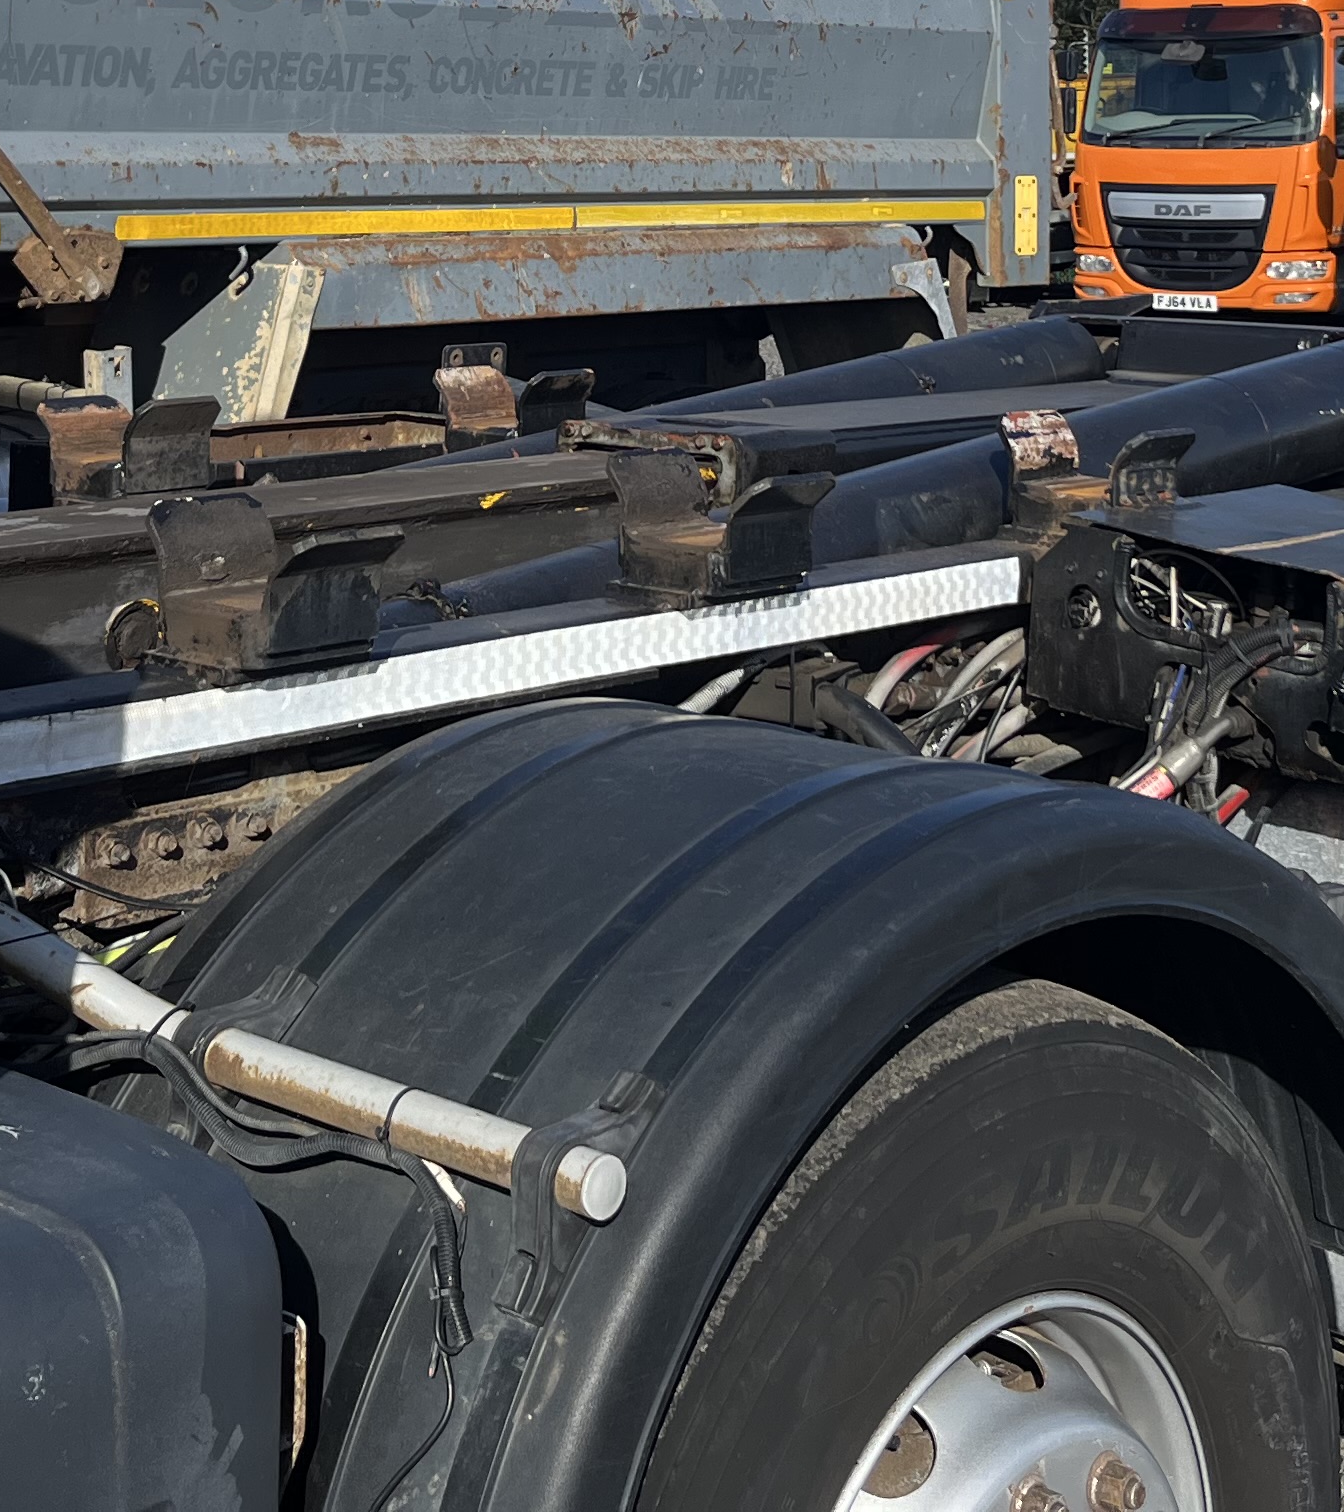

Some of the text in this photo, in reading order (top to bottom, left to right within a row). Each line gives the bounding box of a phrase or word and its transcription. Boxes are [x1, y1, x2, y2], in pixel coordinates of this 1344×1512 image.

[171, 47, 413, 102] AGGREGATES,
[429, 56, 596, 97] CONCRETE
[606, 62, 628, 98] &
[637, 63, 704, 100] SKIP
[714, 65, 778, 101] HIRE
[1154, 204, 1211, 217] DAF
[1157, 295, 1186, 308] FJ64
